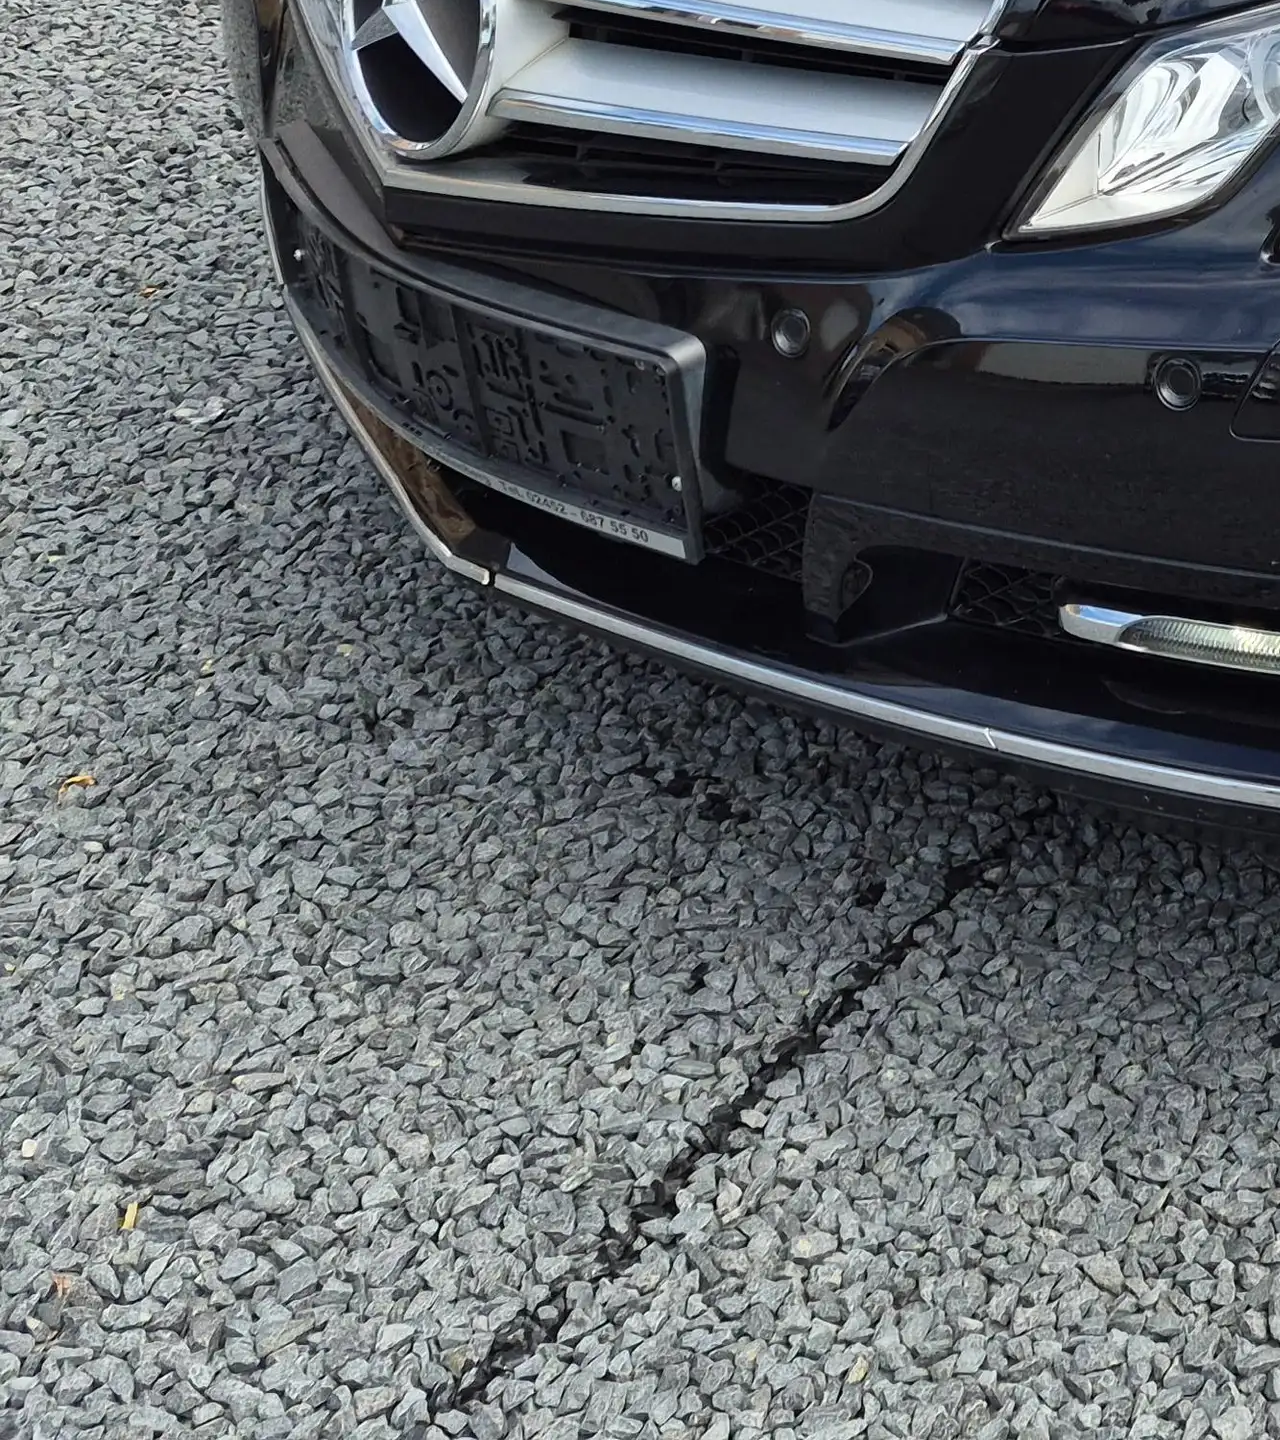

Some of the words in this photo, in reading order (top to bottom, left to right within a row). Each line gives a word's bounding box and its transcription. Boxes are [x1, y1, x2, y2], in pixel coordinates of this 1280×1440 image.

[580, 511, 605, 529] 687
[610, 520, 628, 536] 55
[631, 527, 649, 543] 50
